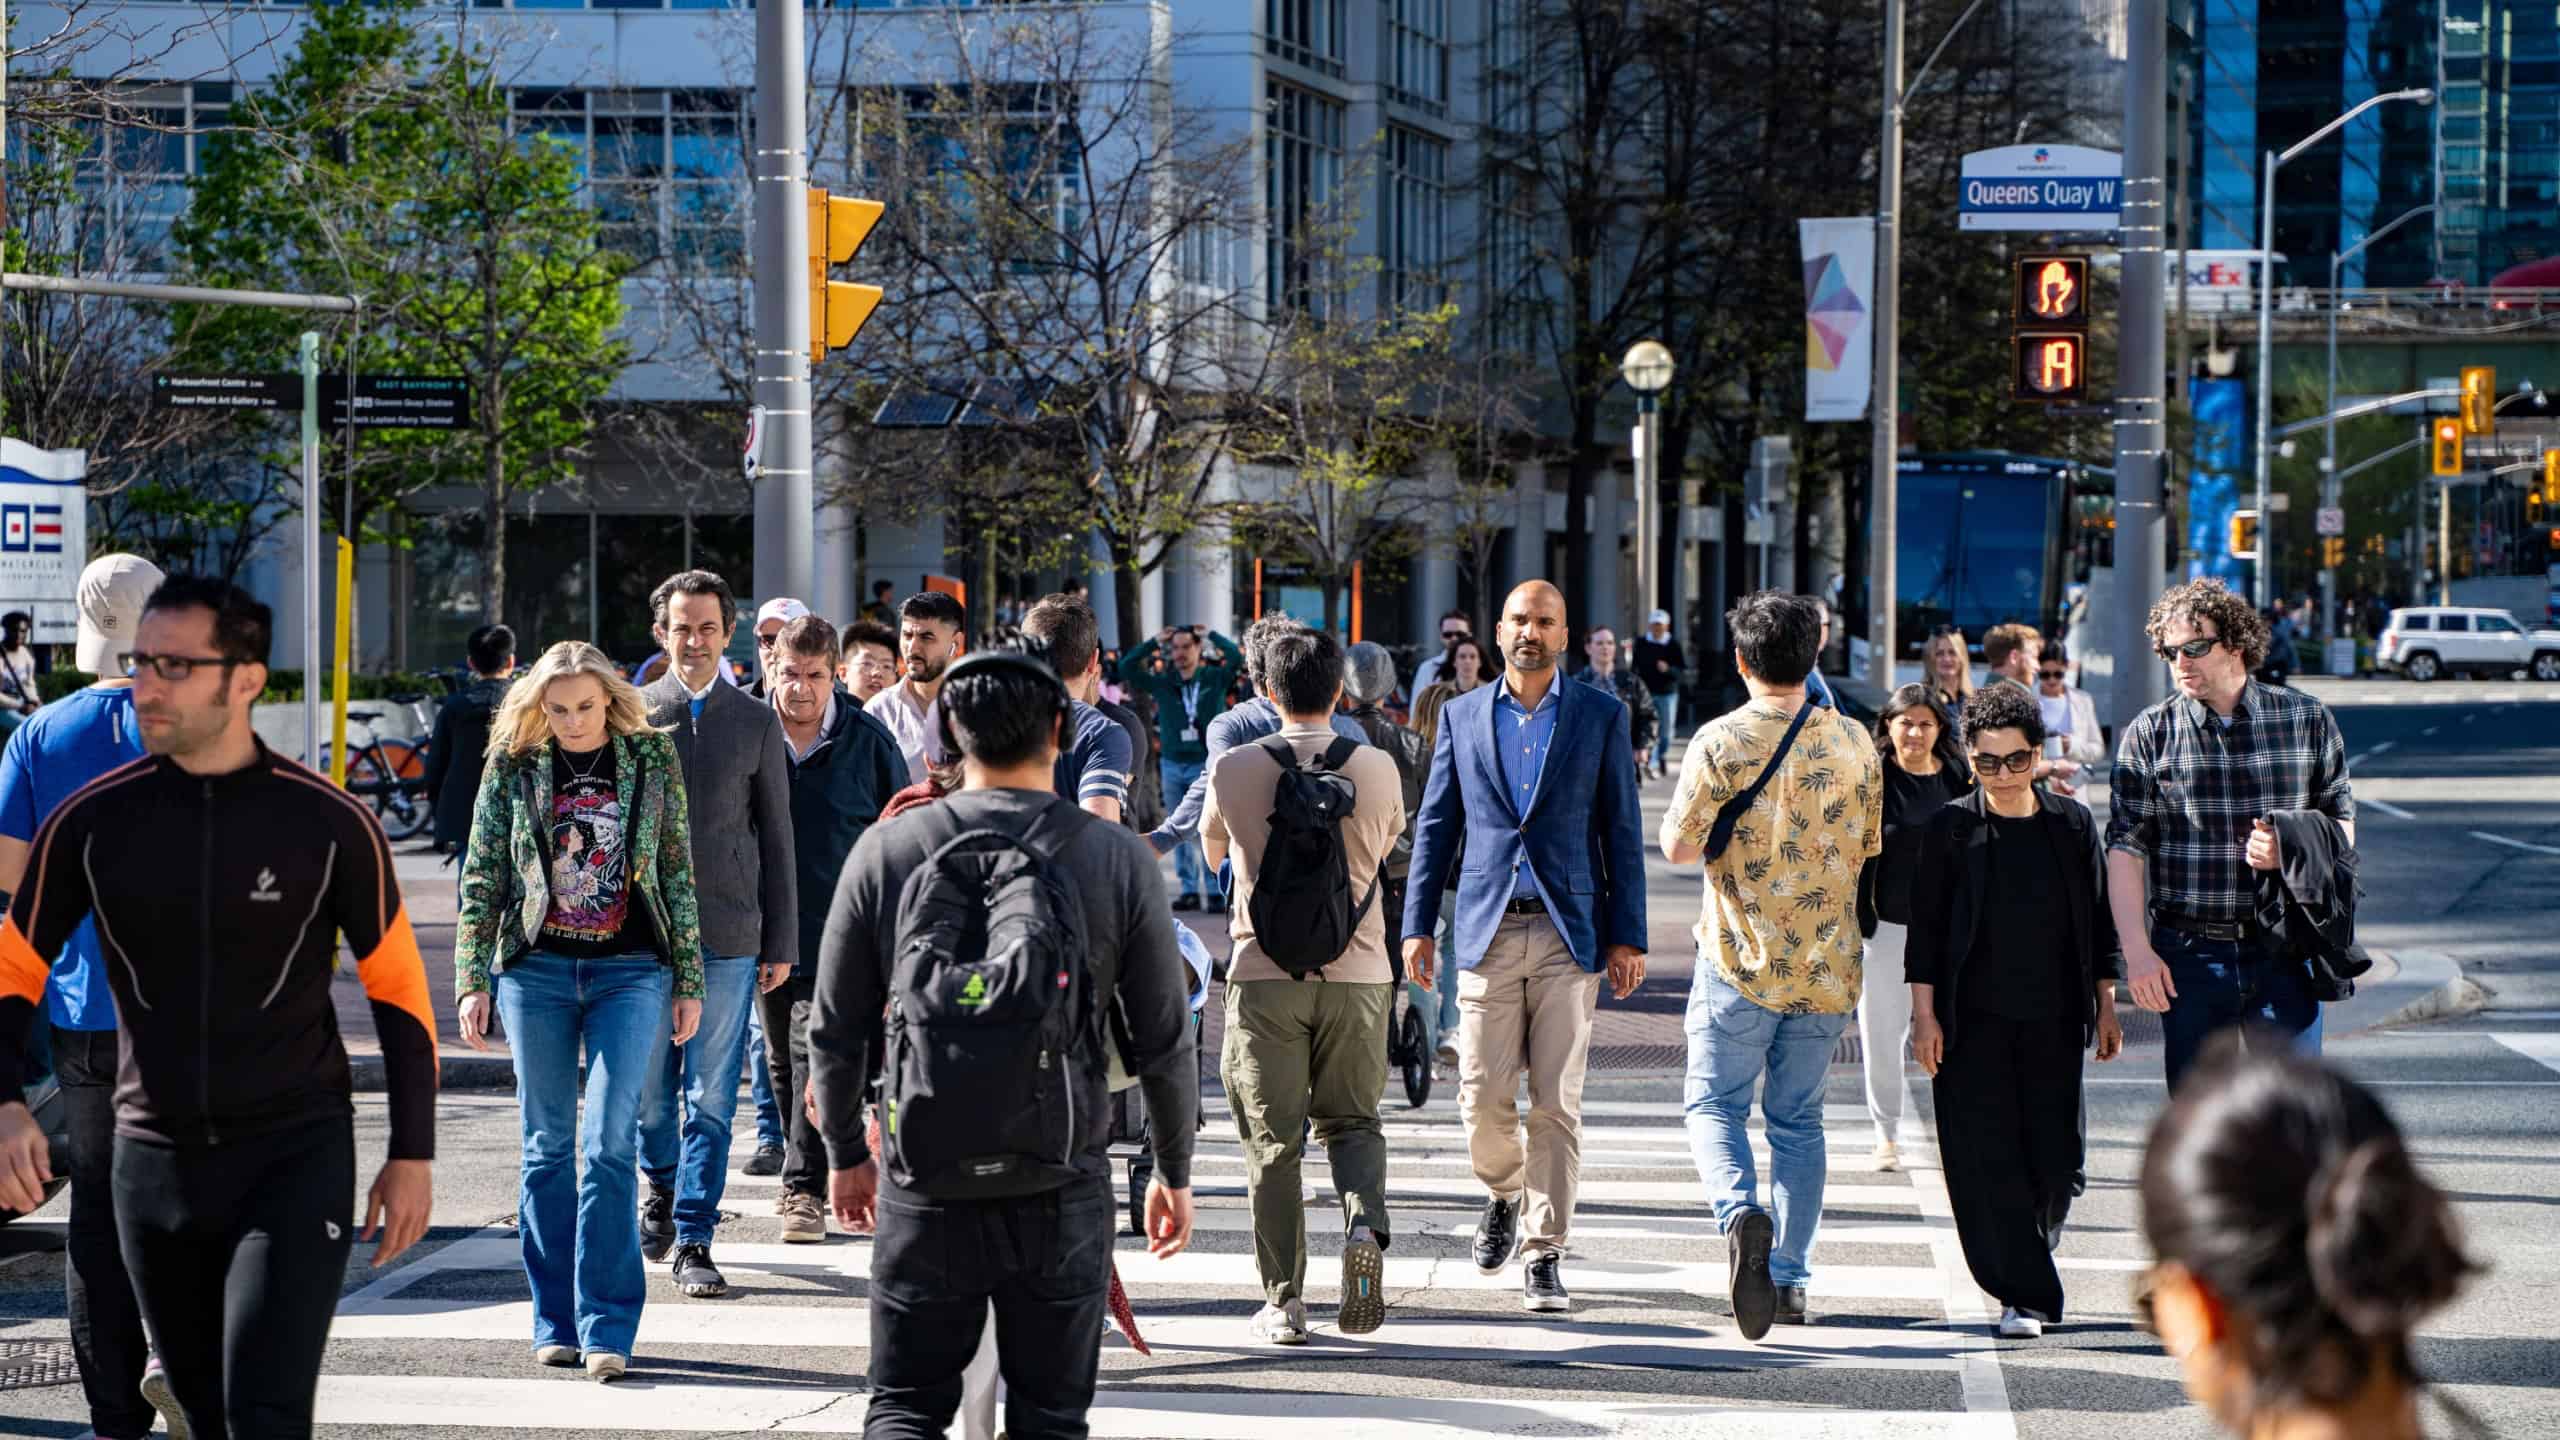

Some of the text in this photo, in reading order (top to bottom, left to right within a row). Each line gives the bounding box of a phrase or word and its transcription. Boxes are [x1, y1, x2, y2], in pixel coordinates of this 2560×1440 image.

[1967, 180, 2115, 210] Queens Quay W
